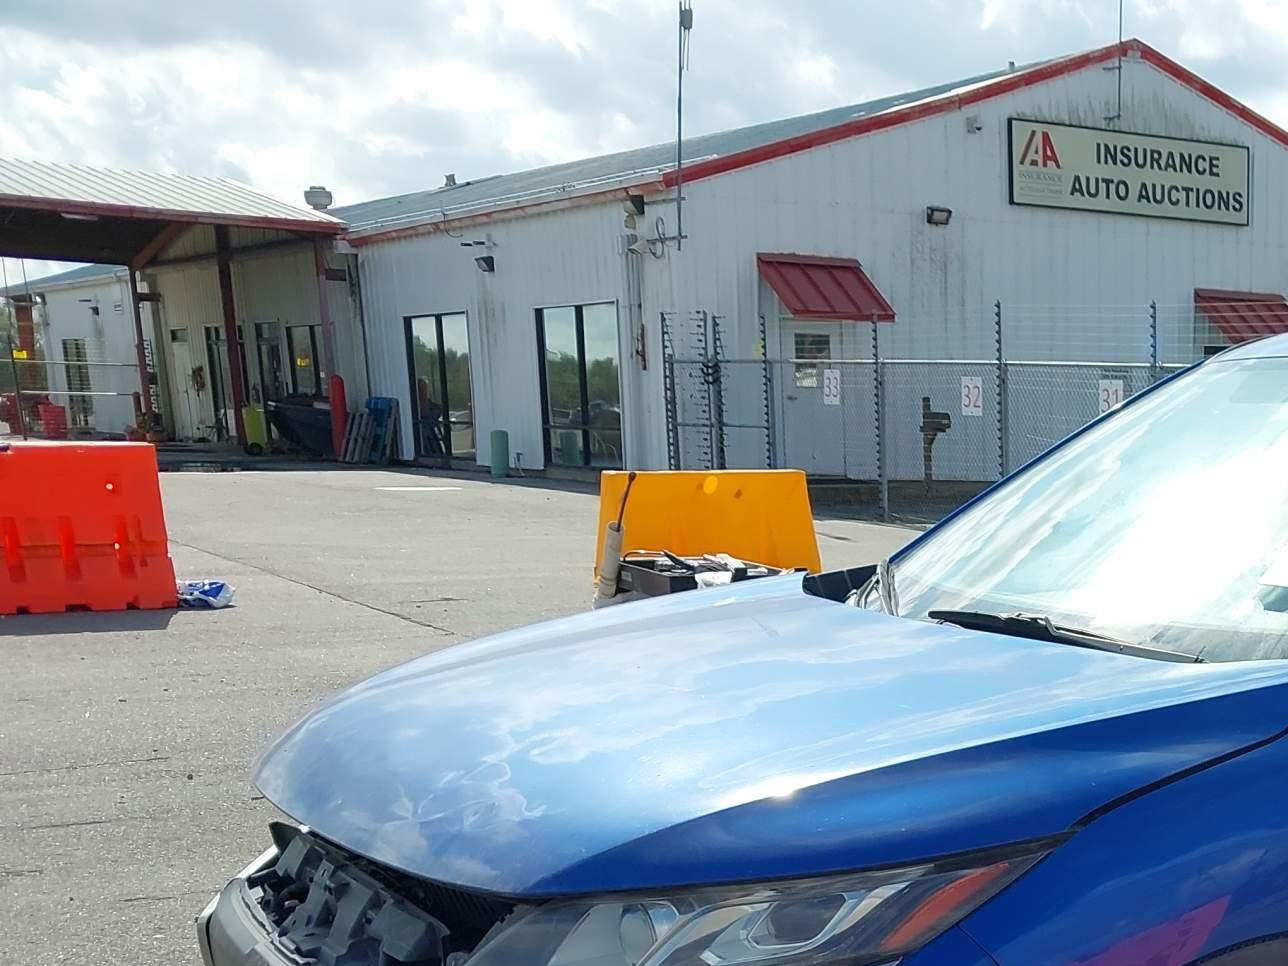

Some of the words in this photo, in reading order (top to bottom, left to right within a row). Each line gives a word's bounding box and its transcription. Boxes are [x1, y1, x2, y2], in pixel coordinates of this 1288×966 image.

[1096, 141, 1221, 178] INSURANCE
[1069, 173, 1130, 202] AUTO
[1136, 181, 1244, 213] AUCTIONS
[825, 376, 840, 398] 33
[962, 384, 981, 409] 32
[1101, 388, 1118, 412] 31
